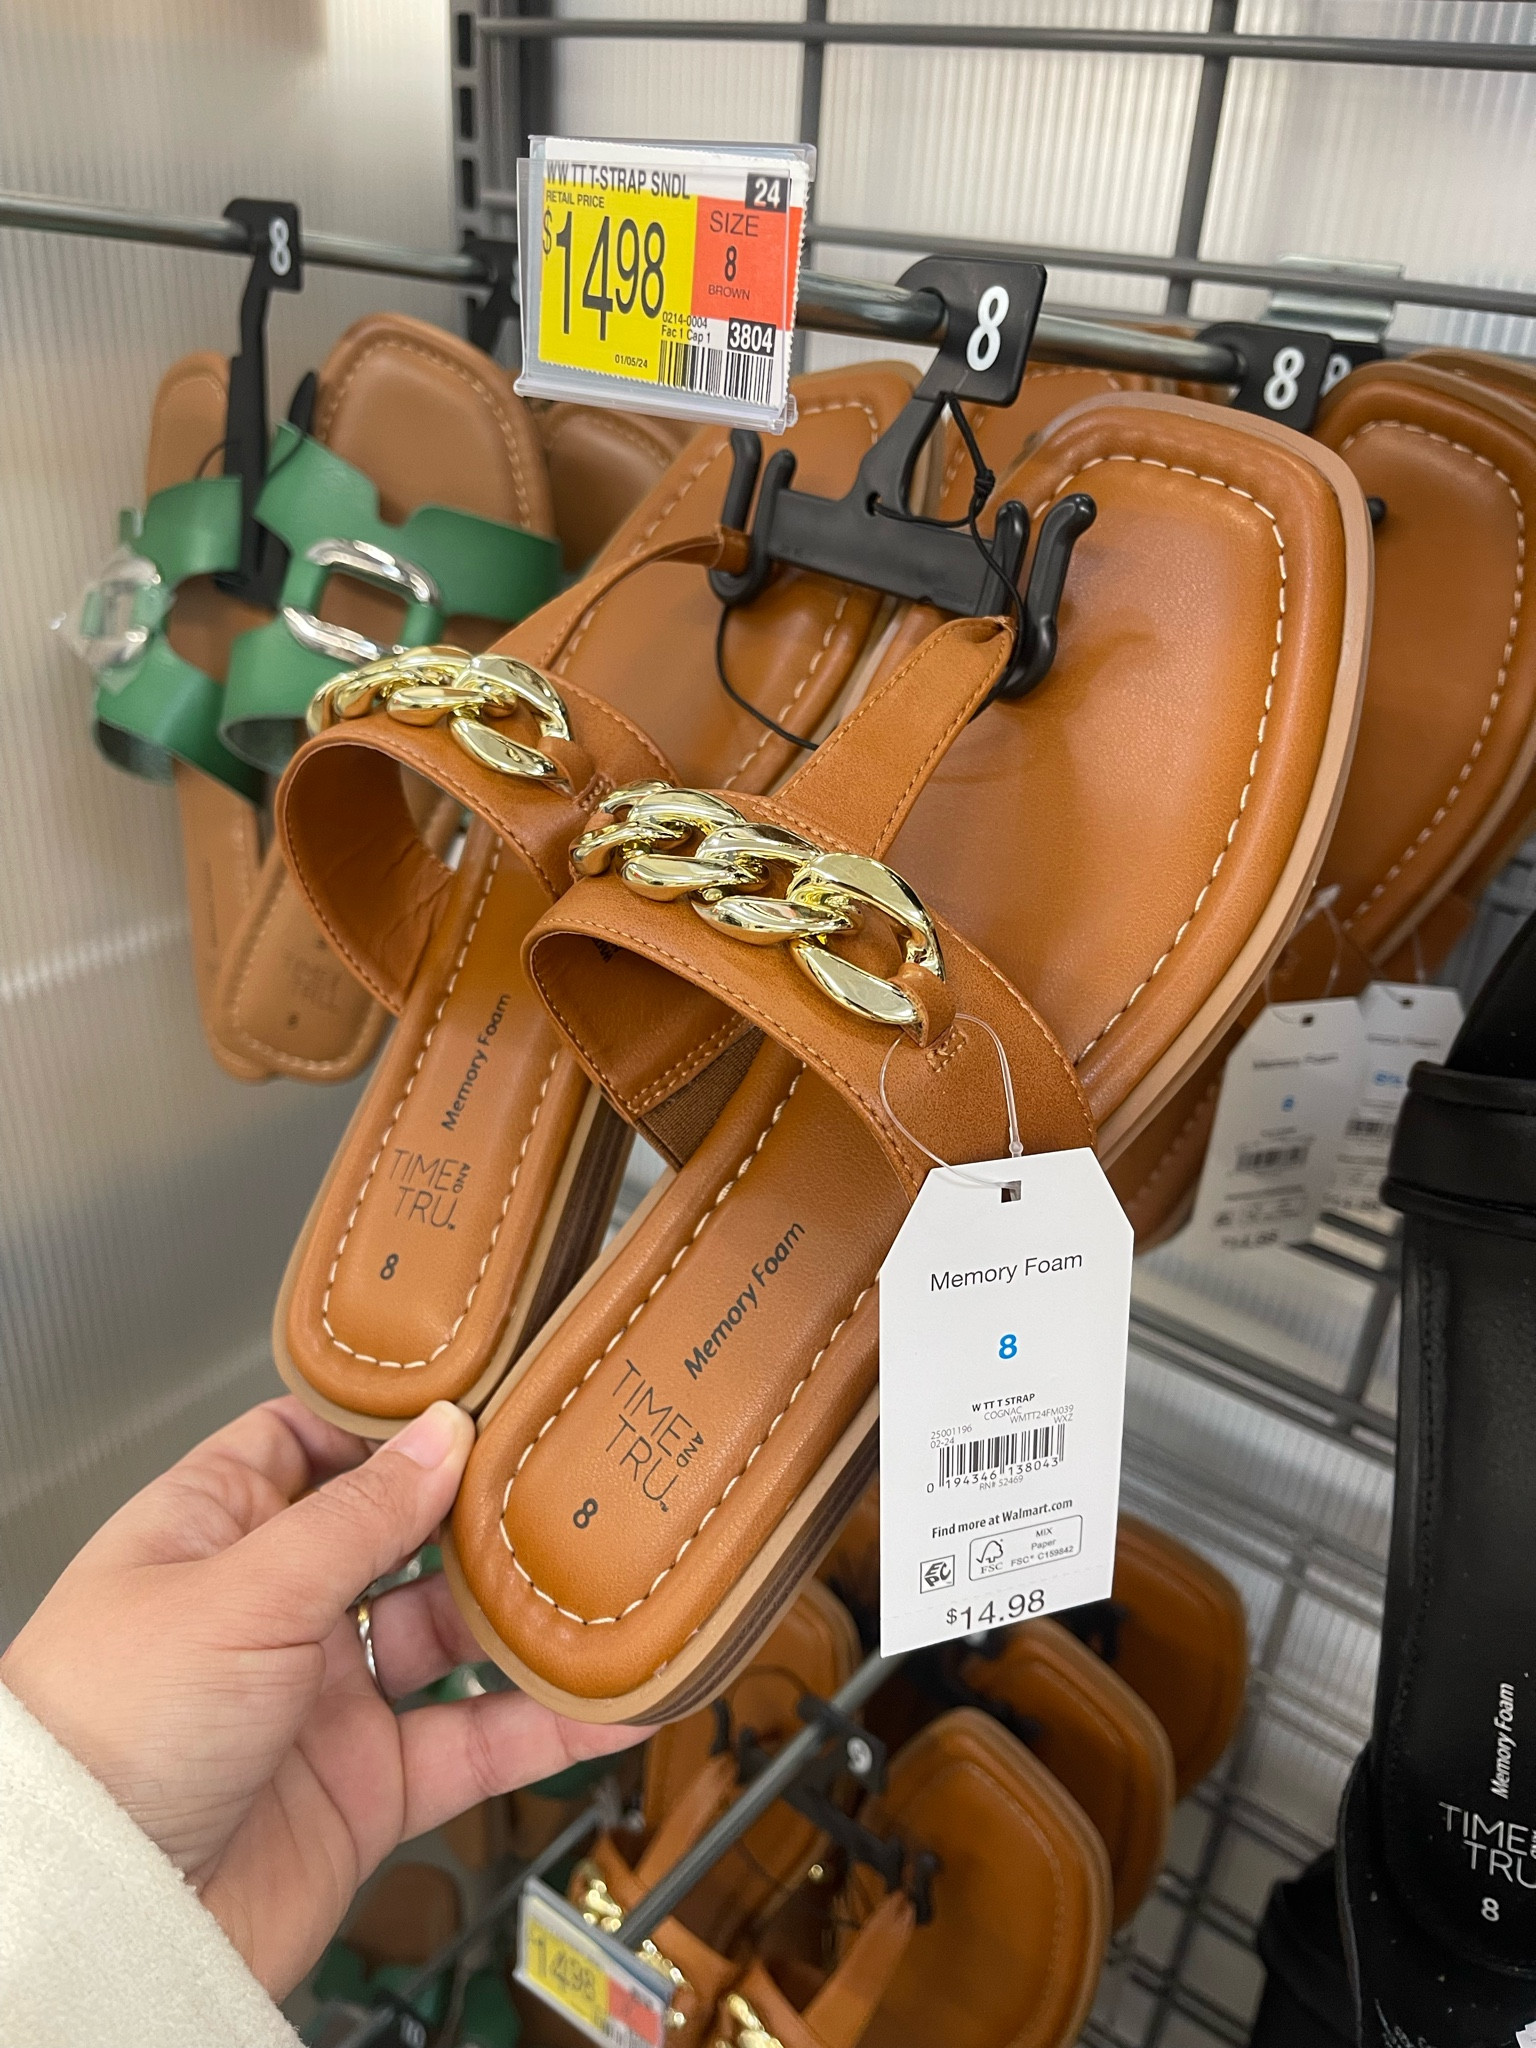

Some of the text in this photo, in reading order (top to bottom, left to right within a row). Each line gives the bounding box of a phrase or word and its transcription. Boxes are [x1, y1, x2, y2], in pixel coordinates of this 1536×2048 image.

[589, 165, 647, 195] T-STRAP
[651, 171, 690, 200] SNDL
[752, 176, 781, 208] 24
[545, 190, 605, 208] RETAIL PRICE
[709, 210, 759, 238] SIZE
[269, 217, 292, 276] 8
[724, 245, 738, 282] 8
[708, 284, 750, 300] BROWN
[661, 325, 711, 344] Fac 1 Cap 1
[662, 311, 708, 329] 0214-0004
[966, 285, 1010, 372] 8
[729, 322, 773, 354] 3804
[614, 354, 648, 369] 01/05/24
[1263, 347, 1305, 411] 8
[441, 993, 511, 1131] Memory Foam
[389, 1148, 459, 1192] TIME
[452, 1162, 471, 1194] AND
[379, 1253, 400, 1281] 8
[930, 1253, 1083, 1292] Memory Foam
[683, 1222, 806, 1380] Memory Foam
[998, 1334, 1018, 1360] 8
[612, 1358, 693, 1458] TIME
[971, 1403, 982, 1413] W
[997, 1399, 1003, 1408] T
[1004, 1393, 1036, 1406] STRAP
[983, 1406, 1023, 1421] COGNAC
[1053, 1413, 1074, 1424] WXZ
[930, 1424, 973, 1440] 25001196
[930, 1437, 955, 1449] 02-24
[676, 1431, 705, 1468] AND
[926, 1456, 1059, 1494] 0 194346 138043
[979, 1475, 1024, 1491] RN# 52469
[572, 1497, 599, 1530] 8
[932, 1499, 1073, 1539] Find more at Walmart.com
[1031, 1538, 1057, 1551] Paper
[1035, 1527, 1054, 1538] MIX
[980, 1562, 1003, 1575] FSC
[946, 1589, 1046, 1630] $14.98
[1490, 1682, 1517, 1800] Memory Foam
[1438, 1801, 1529, 1857] TIME
[1480, 1897, 1500, 1921] 8
